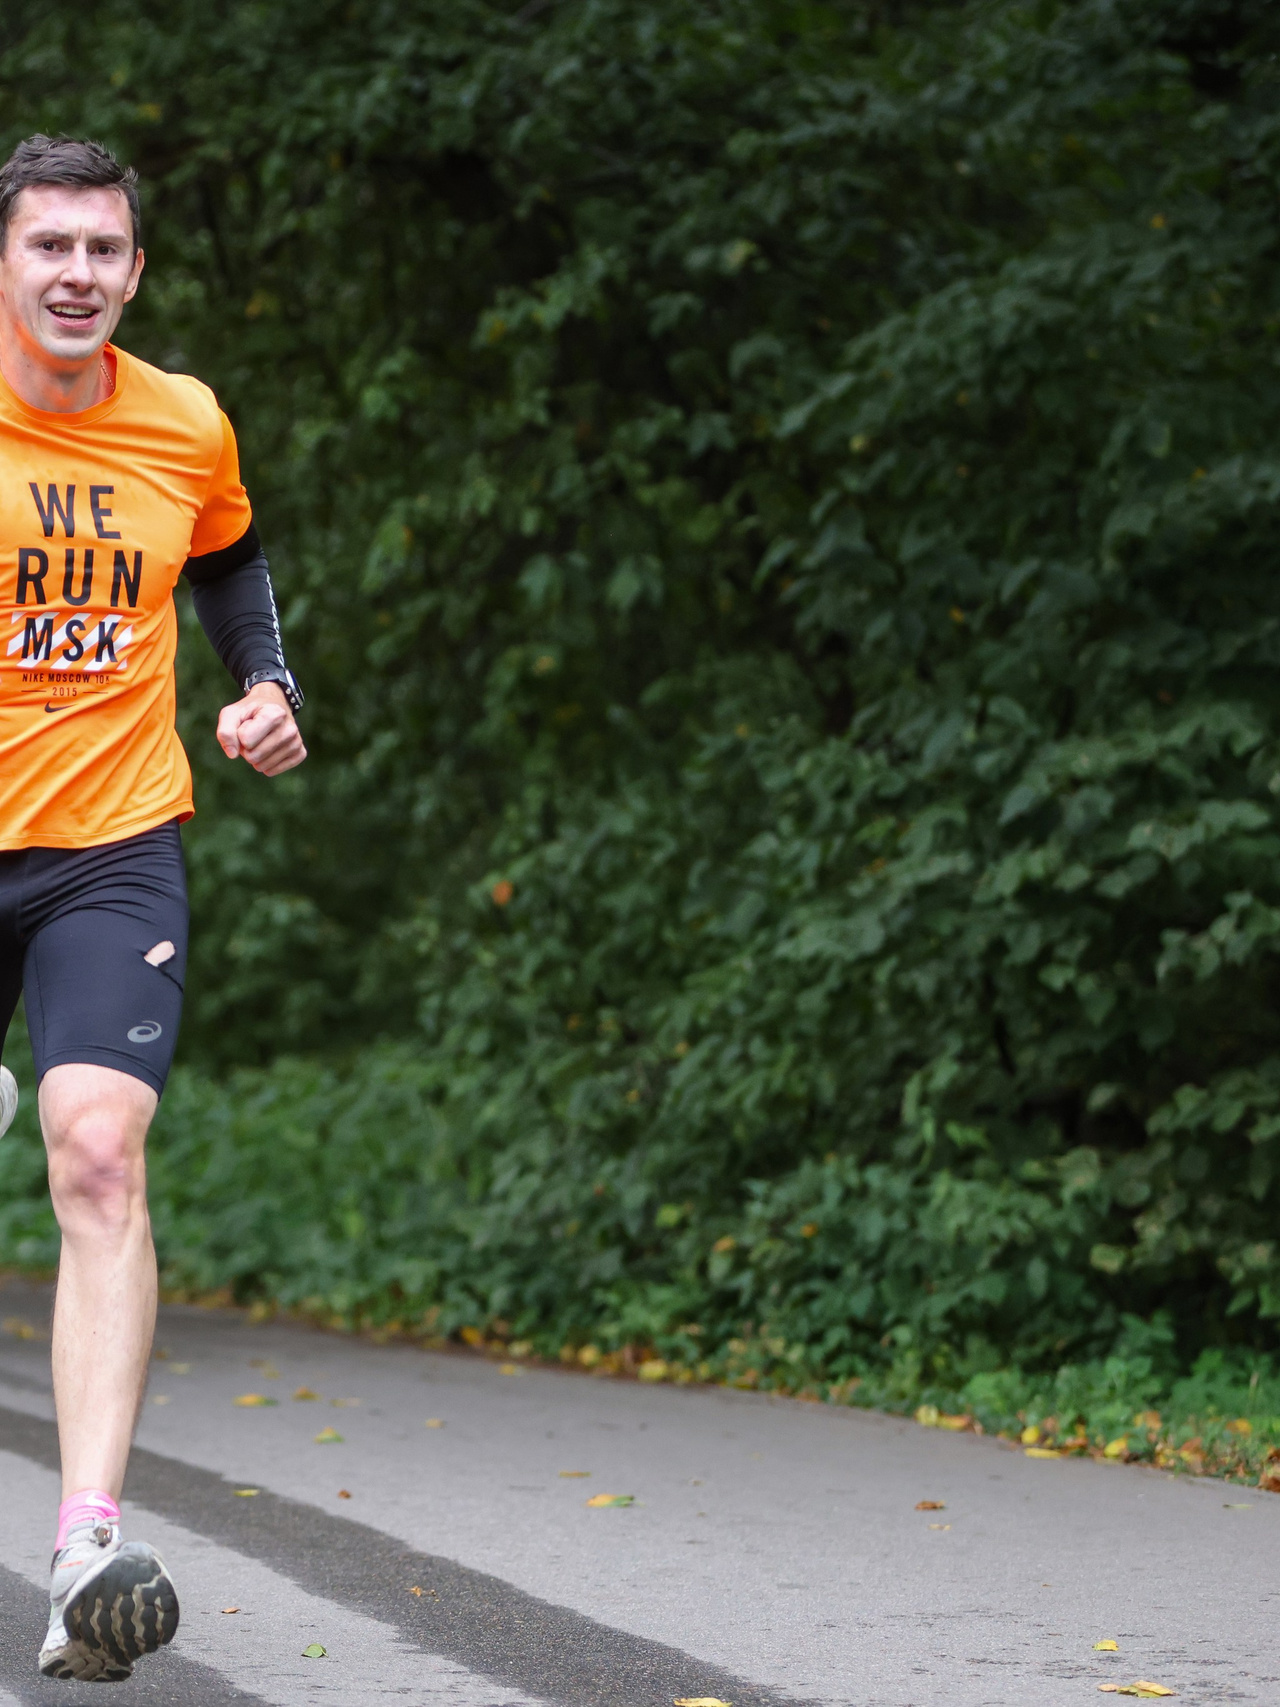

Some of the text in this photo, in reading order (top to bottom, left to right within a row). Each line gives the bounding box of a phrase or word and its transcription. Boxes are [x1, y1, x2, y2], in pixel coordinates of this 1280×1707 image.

[29, 482, 121, 539] WE
[16, 548, 143, 608] RUN
[21, 617, 119, 663] MSK
[22, 673, 44, 682] NIKE
[48, 673, 90, 683] MOSCOW
[52, 687, 77, 697] 2015
